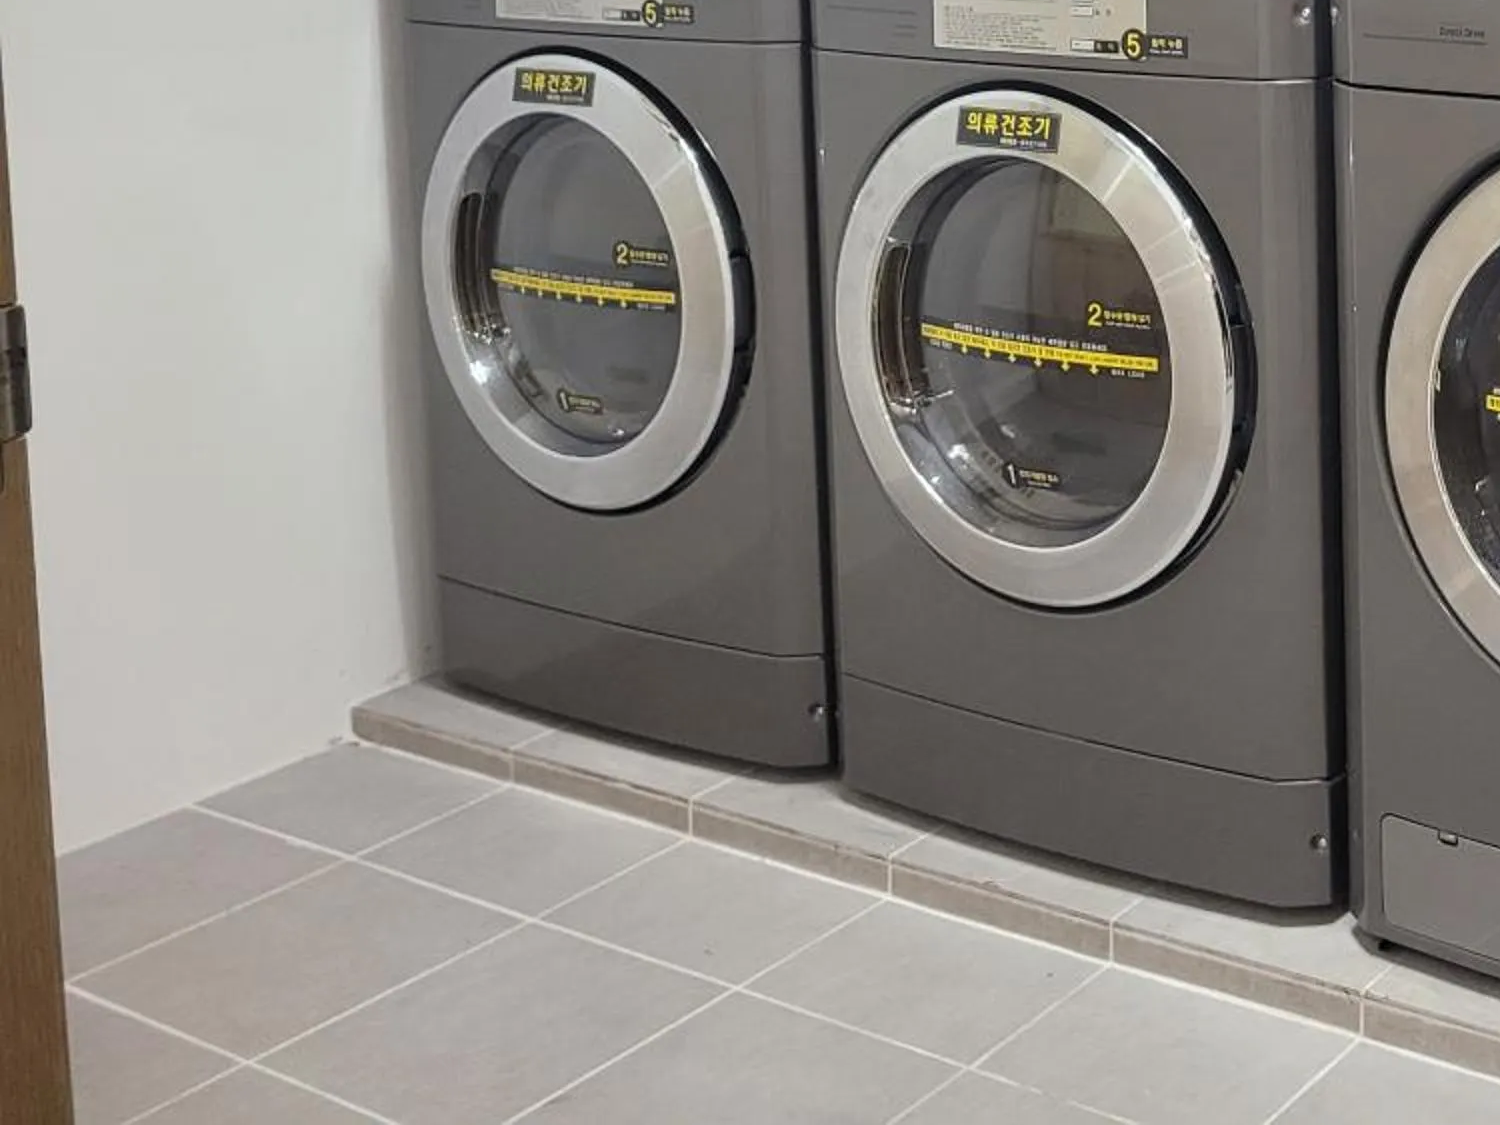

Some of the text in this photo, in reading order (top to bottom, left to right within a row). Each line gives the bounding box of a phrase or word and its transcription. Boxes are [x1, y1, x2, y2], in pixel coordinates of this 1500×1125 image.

[1127, 33, 1140, 58] 5
[965, 113, 1050, 139] 의류건조기
[617, 244, 628, 264] 2
[1088, 303, 1102, 326] 2
